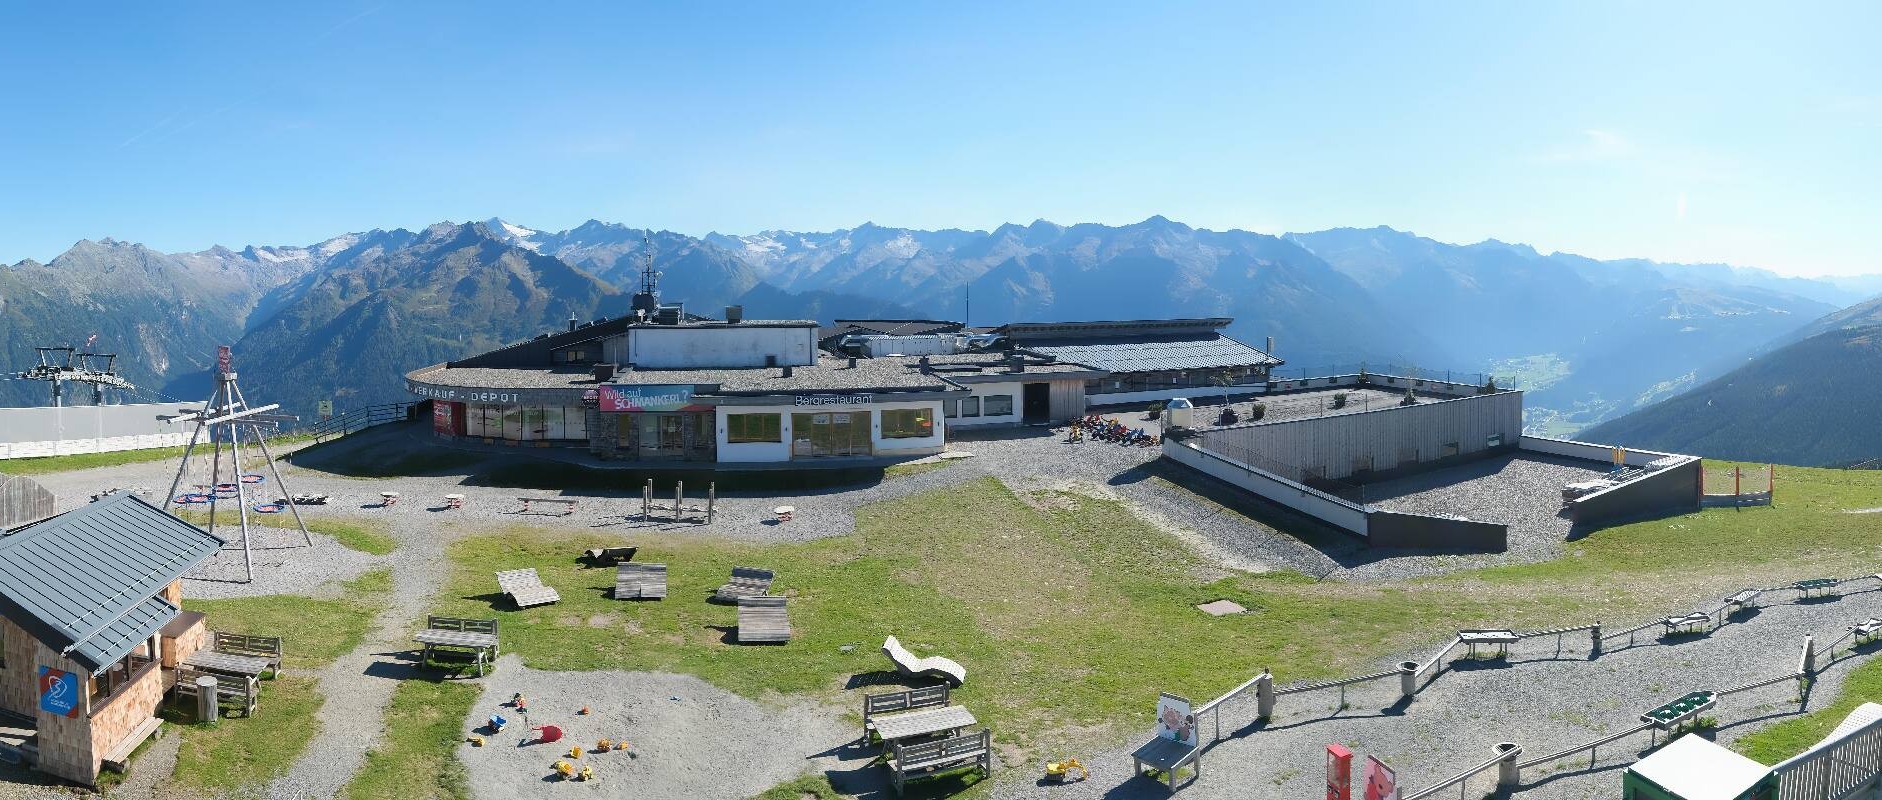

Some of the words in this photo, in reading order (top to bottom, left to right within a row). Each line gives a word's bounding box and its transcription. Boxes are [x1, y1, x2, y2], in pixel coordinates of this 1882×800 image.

[414, 387, 455, 399] VERKAUF
[471, 392, 519, 402] DEPOT
[604, 389, 624, 399] Wild
[626, 387, 641, 398] auf
[615, 389, 689, 409] SCHMANKERL?
[795, 395, 872, 406] Bergrestaurant
